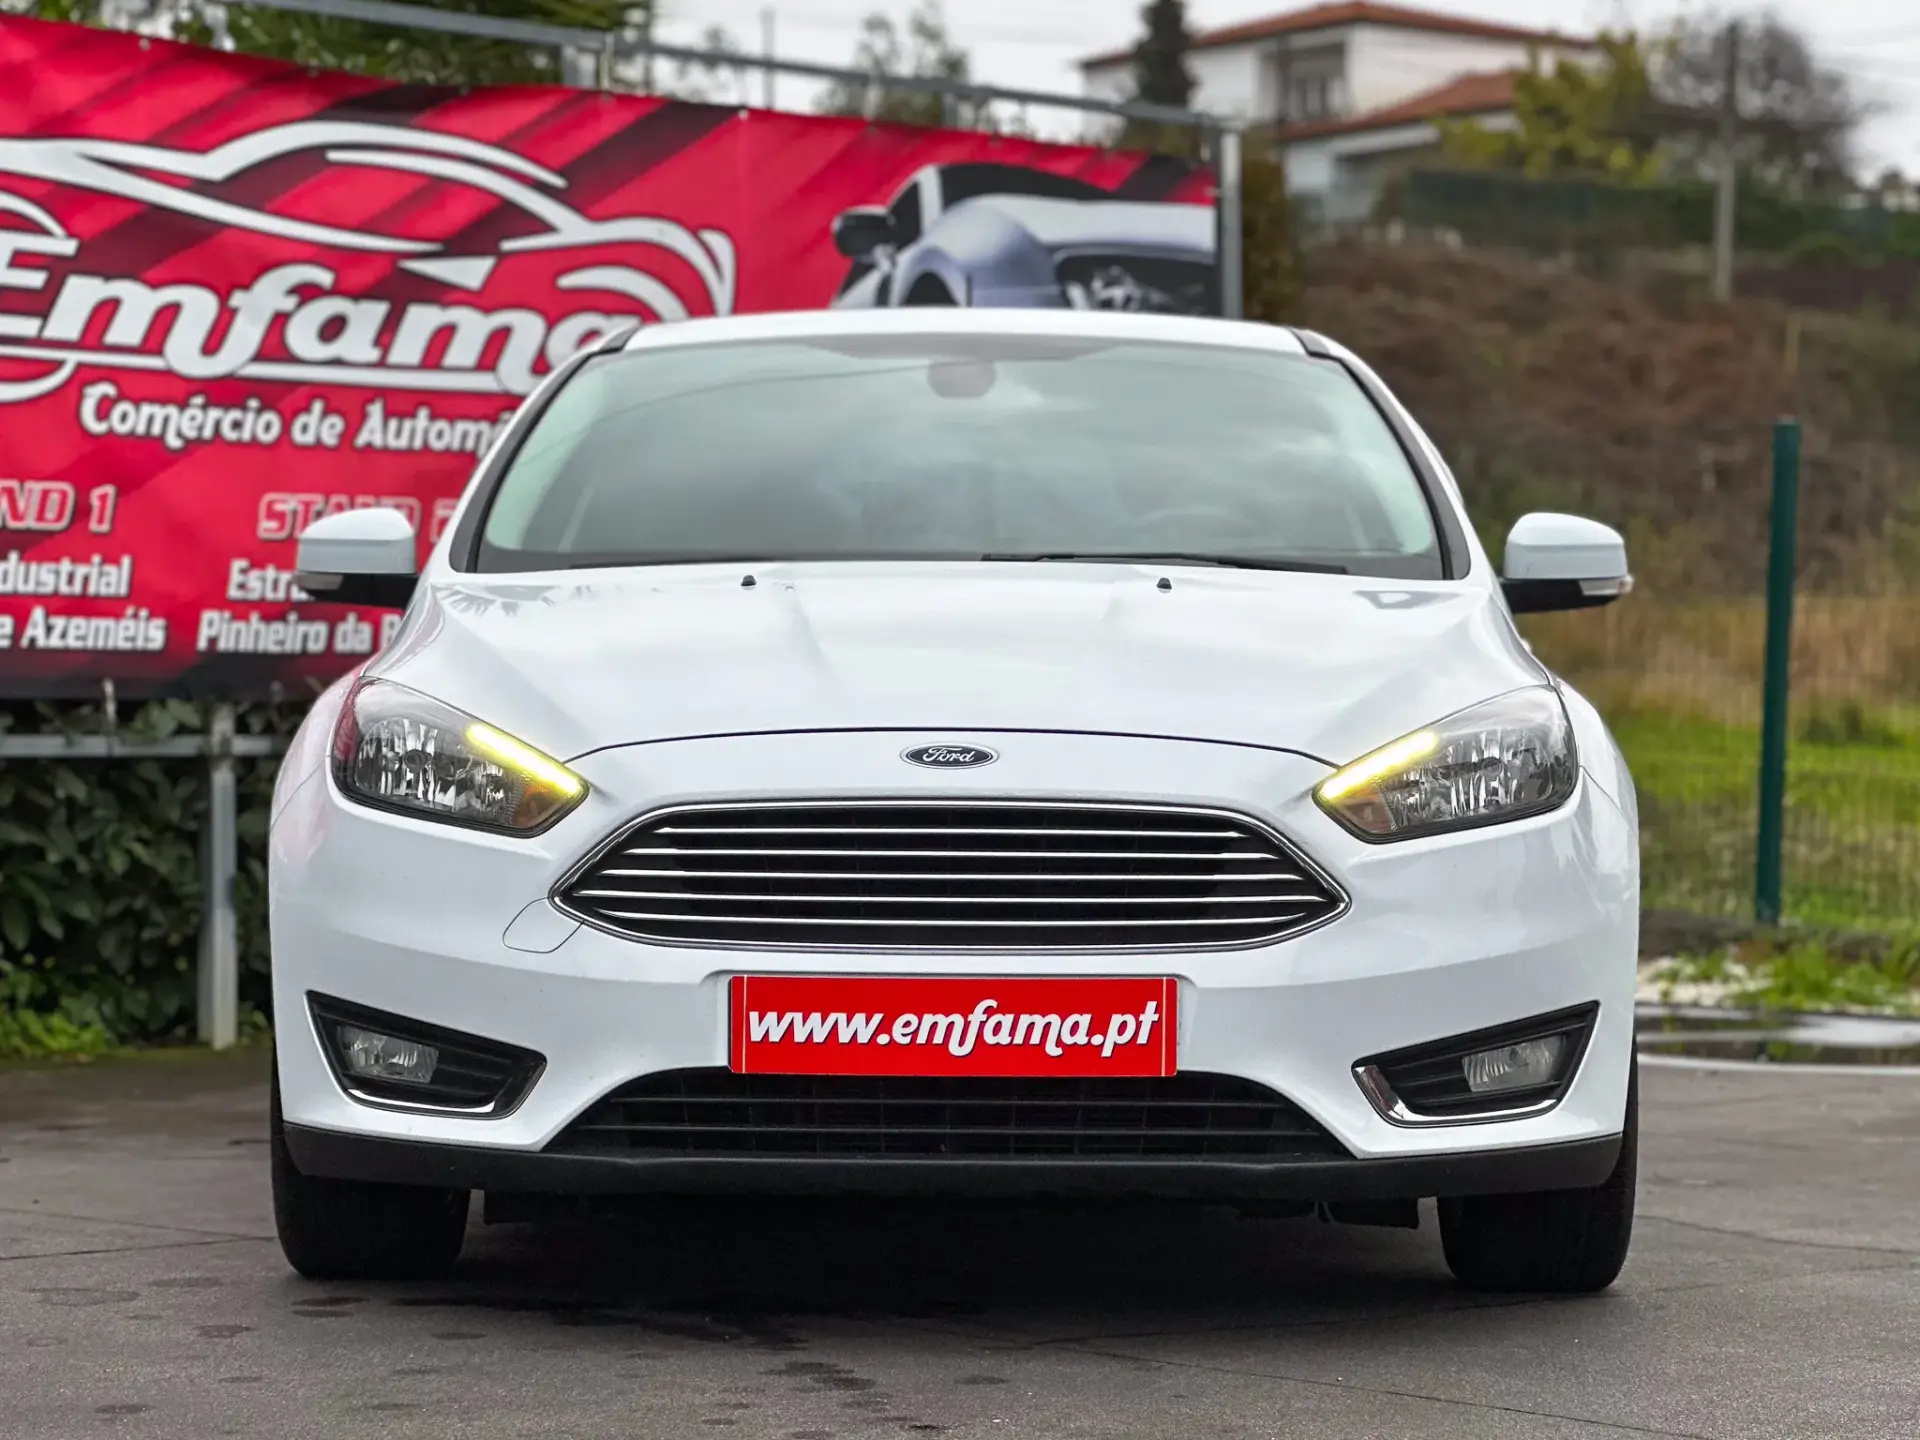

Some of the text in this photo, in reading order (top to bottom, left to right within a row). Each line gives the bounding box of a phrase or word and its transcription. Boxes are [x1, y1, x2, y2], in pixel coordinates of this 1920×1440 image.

[82, 384, 279, 448] Comércio
[291, 403, 345, 446] de
[89, 484, 117, 533] 1
[20, 605, 167, 652] Azeméis
[197, 609, 329, 654] Pinheiro
[333, 613, 373, 654] da
[923, 746, 975, 762] Ford
[748, 999, 1159, 1057] www.emfama.pt
